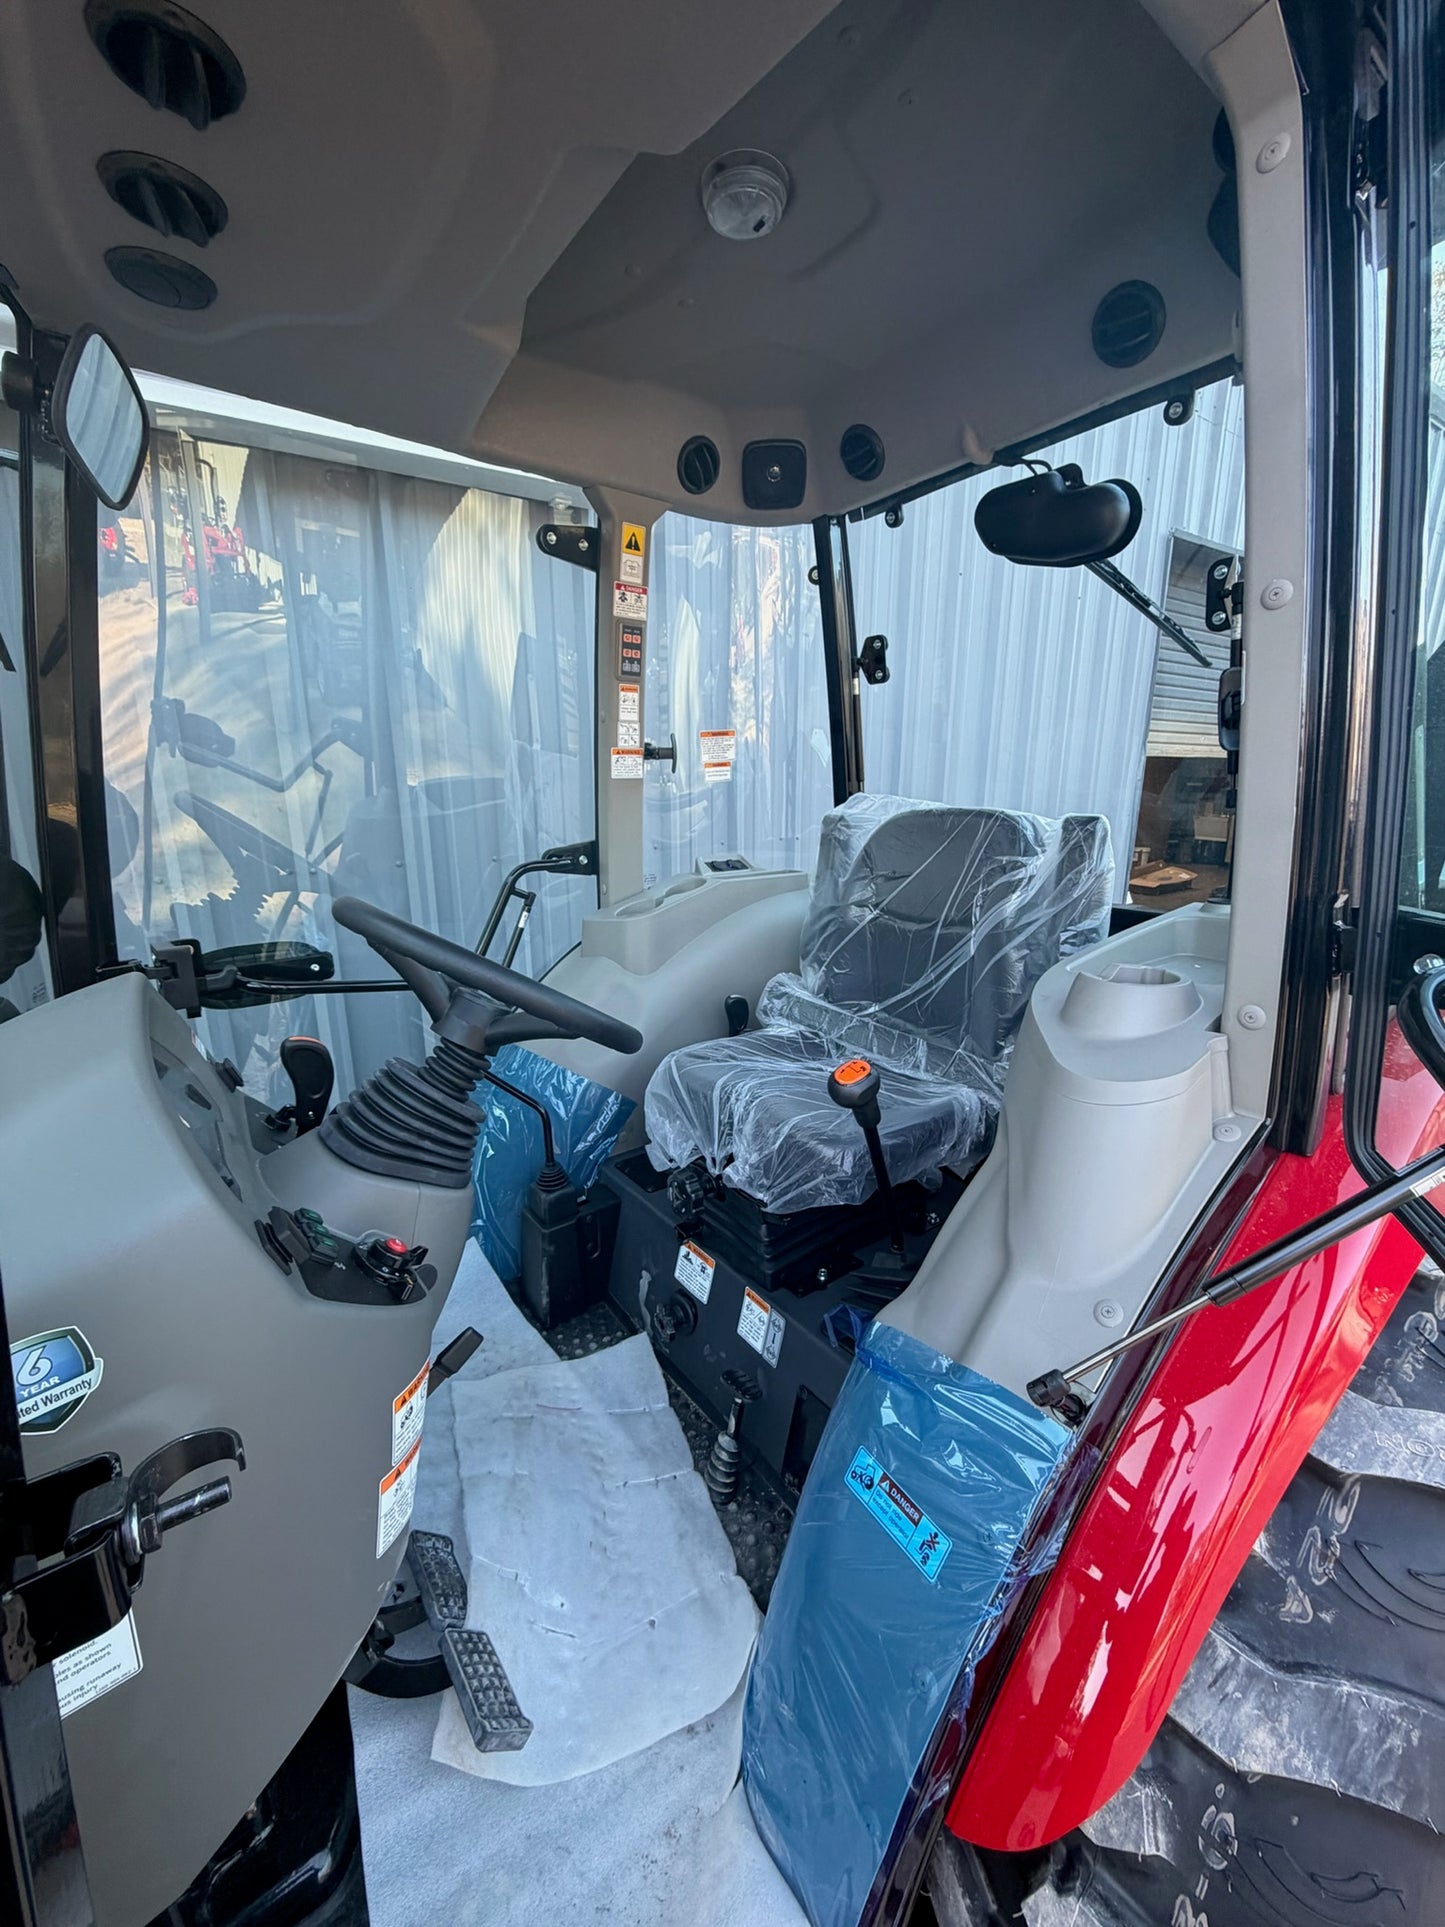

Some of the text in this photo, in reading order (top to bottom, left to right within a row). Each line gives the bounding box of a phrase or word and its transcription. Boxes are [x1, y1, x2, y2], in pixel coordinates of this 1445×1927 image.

[16, 1345, 53, 1387] 6
[19, 1376, 61, 1398] YEAR
[41, 1378, 92, 1407] Warranty
[890, 1487, 920, 1523] DANGER
[70, 1651, 111, 1677] operators
[73, 1660, 83, 1668] as
[84, 1643, 112, 1661] shown
[86, 1663, 122, 1686] runaway
[73, 1684, 98, 1701] injury
